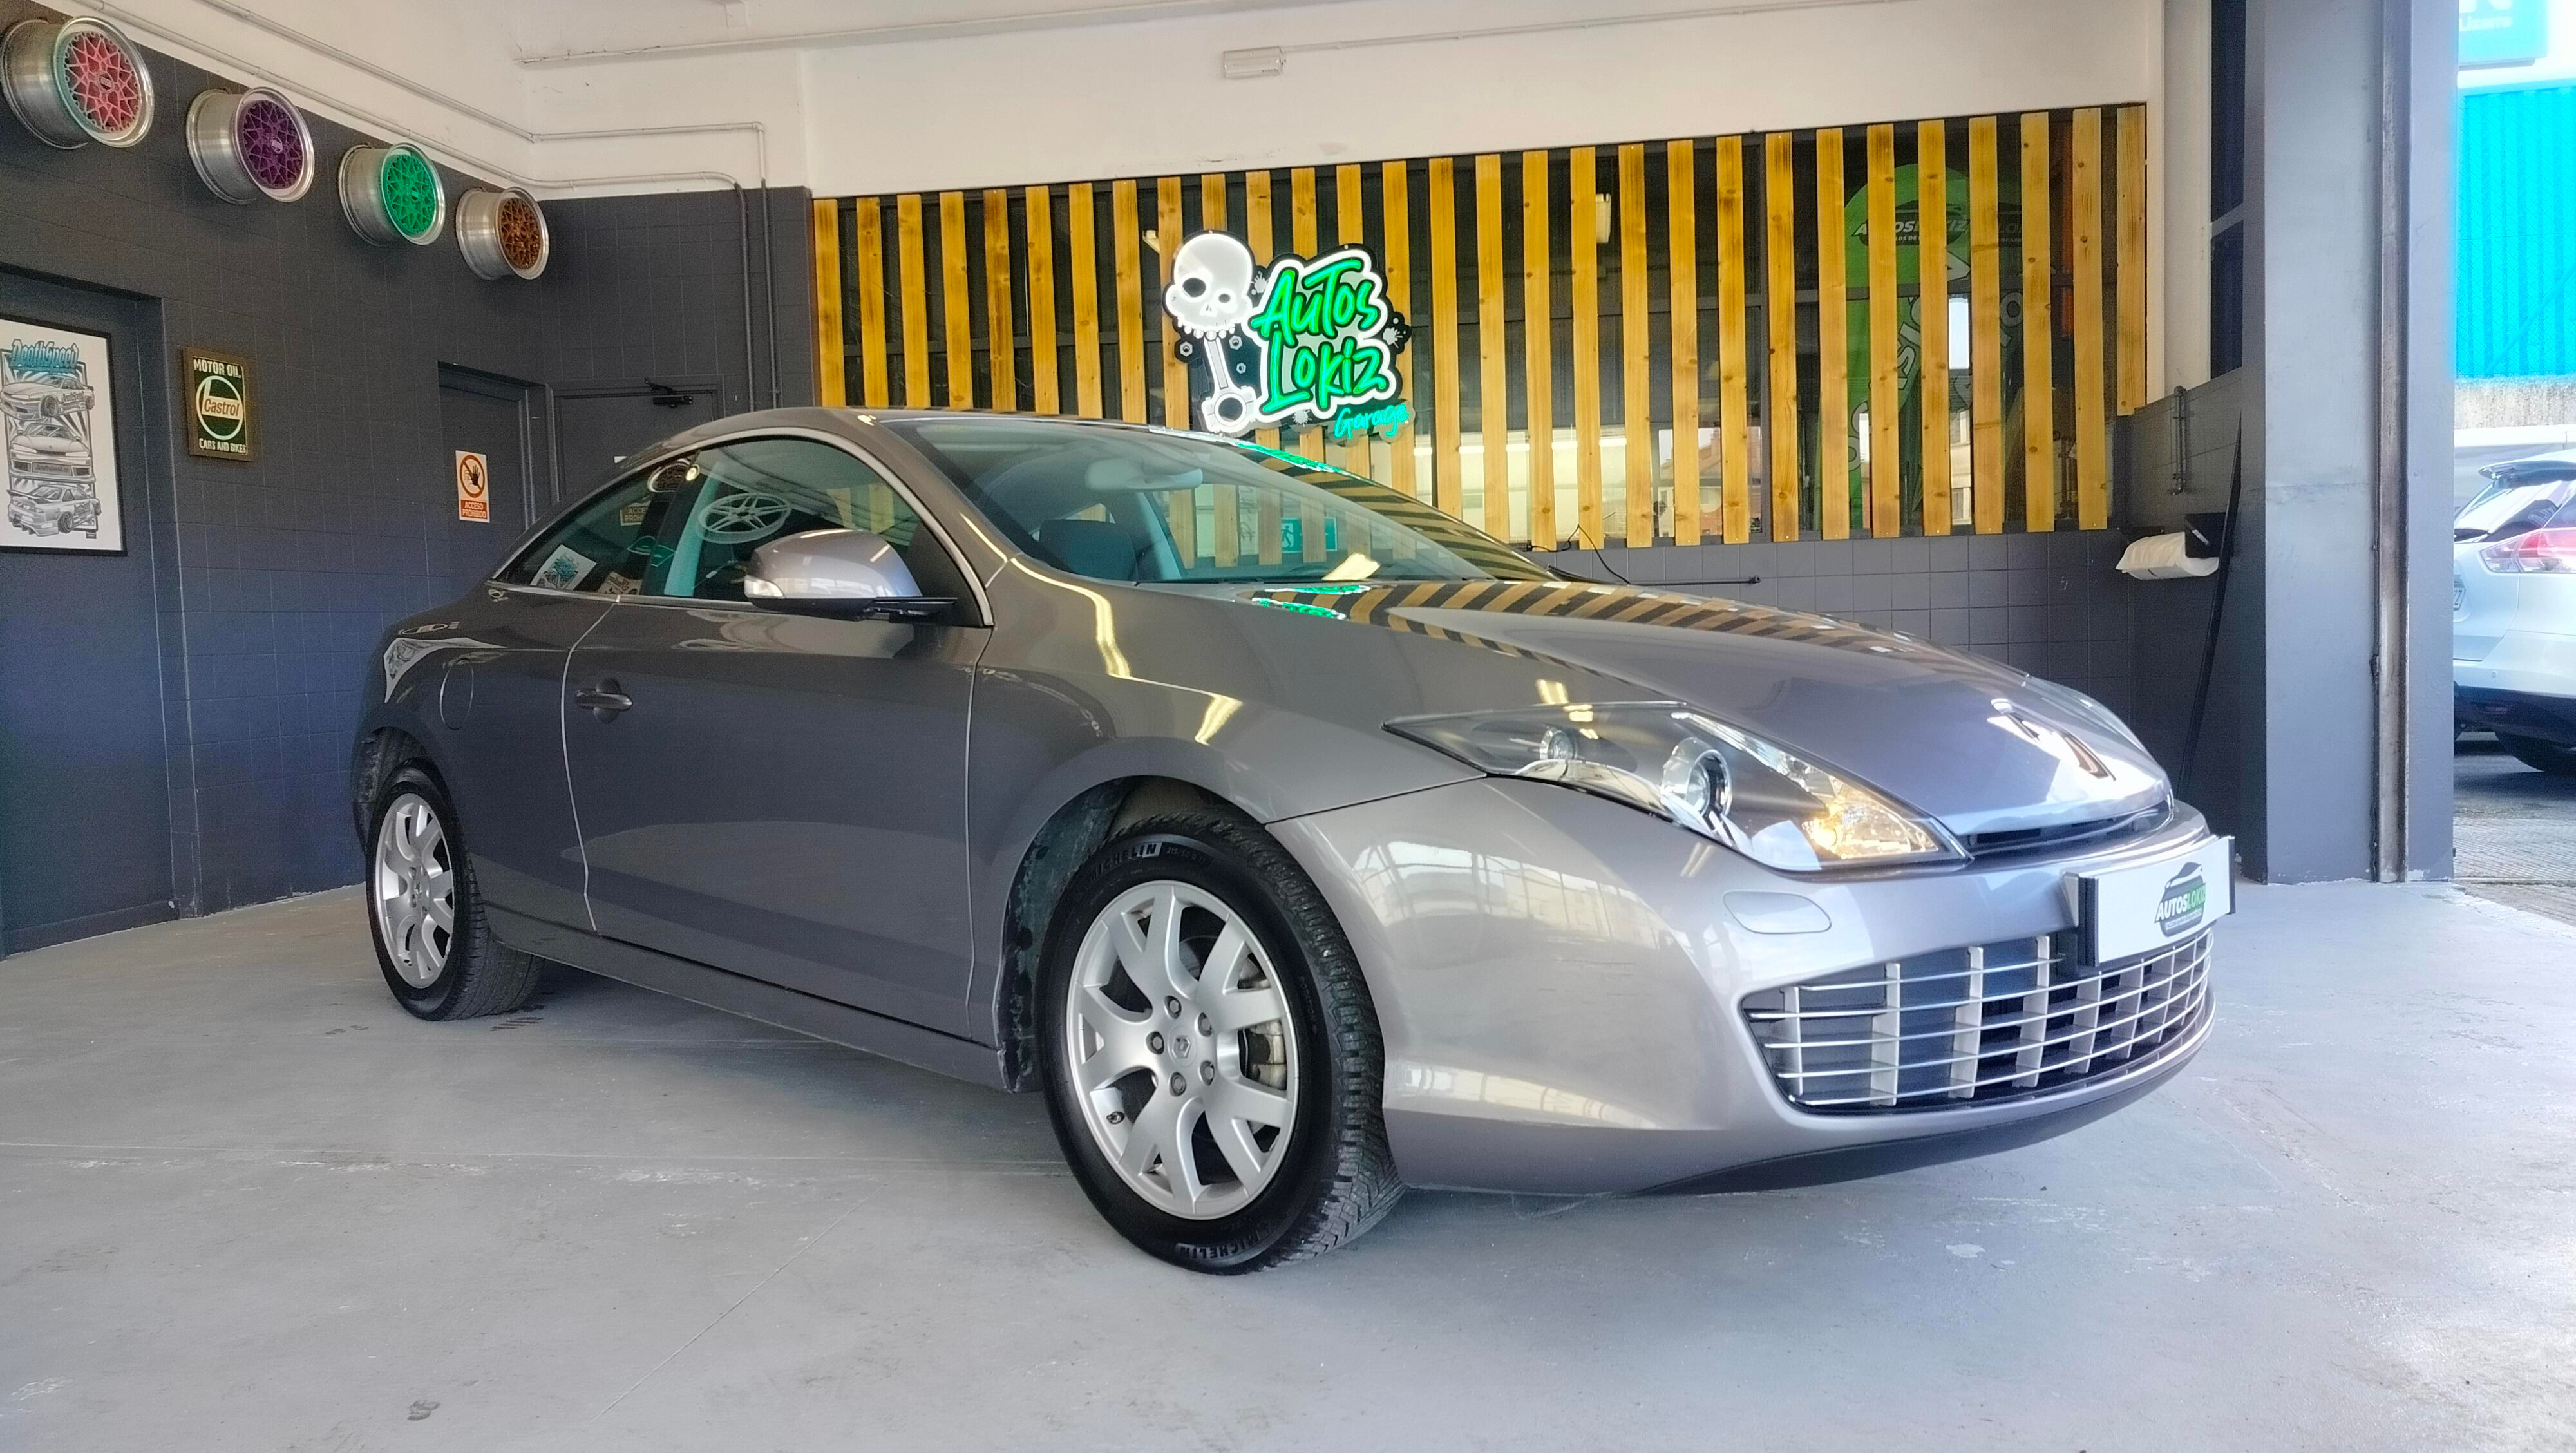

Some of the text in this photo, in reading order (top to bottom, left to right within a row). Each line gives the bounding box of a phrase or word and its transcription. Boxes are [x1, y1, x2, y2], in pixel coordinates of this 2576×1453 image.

[193, 359, 242, 378] MOTOR OIL
[204, 398, 240, 417] Castrol
[1334, 403, 1409, 439] Garage
[199, 438, 246, 453] CARS AND BIKES
[462, 508, 487, 518] PROHIBIDO
[464, 501, 484, 510] ACCESO
